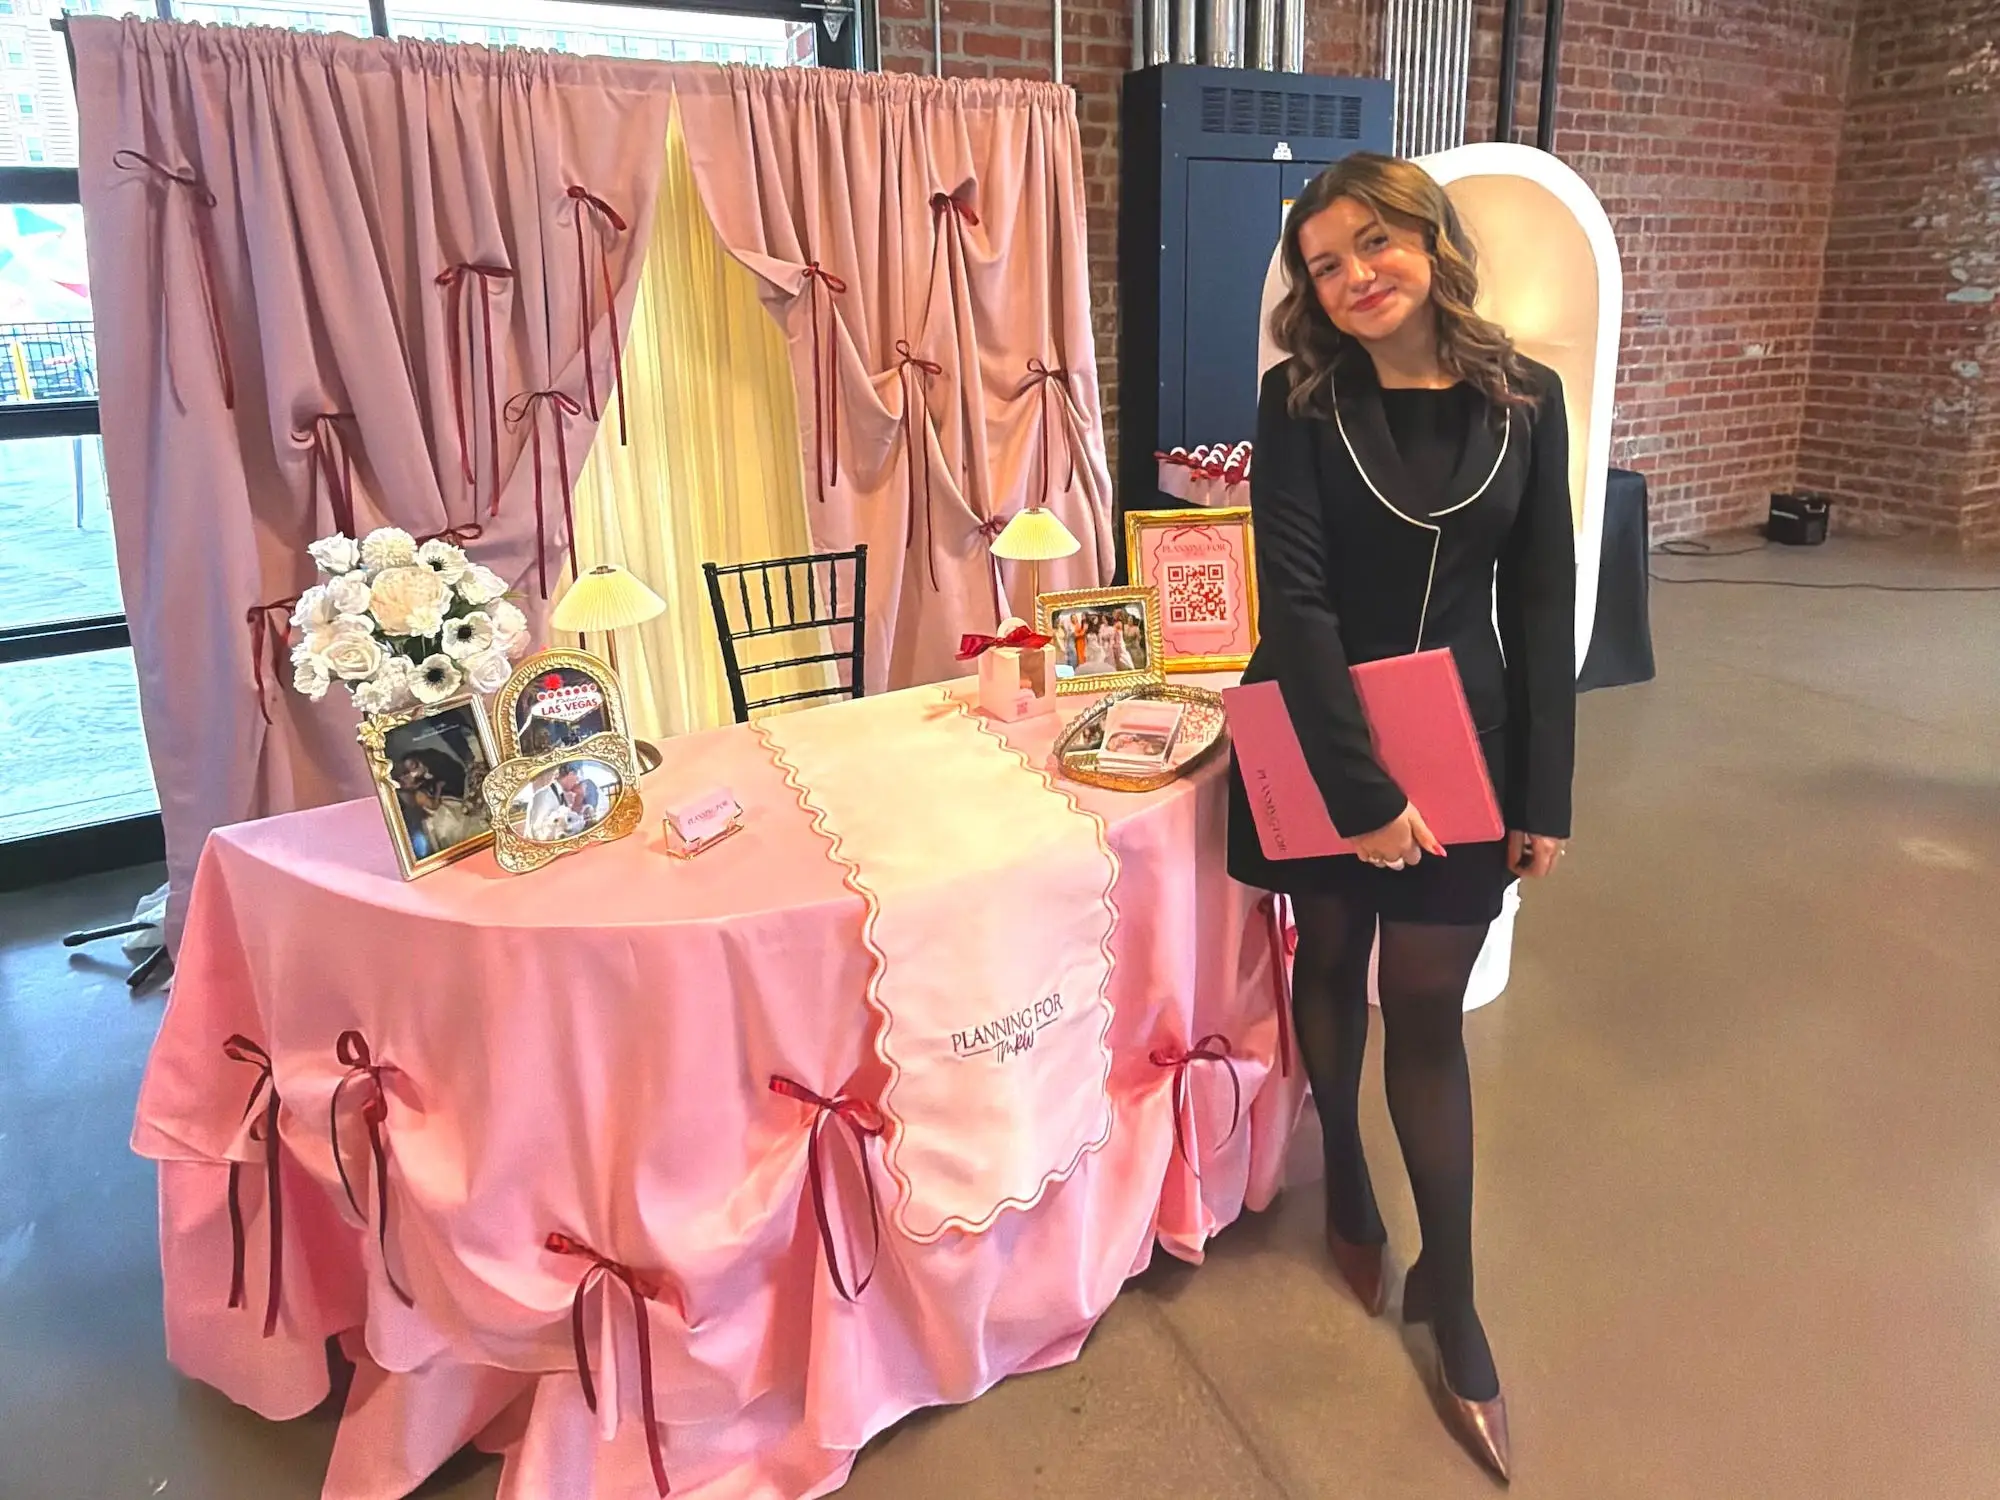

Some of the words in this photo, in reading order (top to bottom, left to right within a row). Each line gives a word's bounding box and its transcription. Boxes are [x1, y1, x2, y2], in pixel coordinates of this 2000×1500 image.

[541, 705, 561, 716] LAS
[564, 698, 598, 711] VEGAS
[951, 1007, 1033, 1052] PLANNING
[1034, 993, 1063, 1022] FOR
